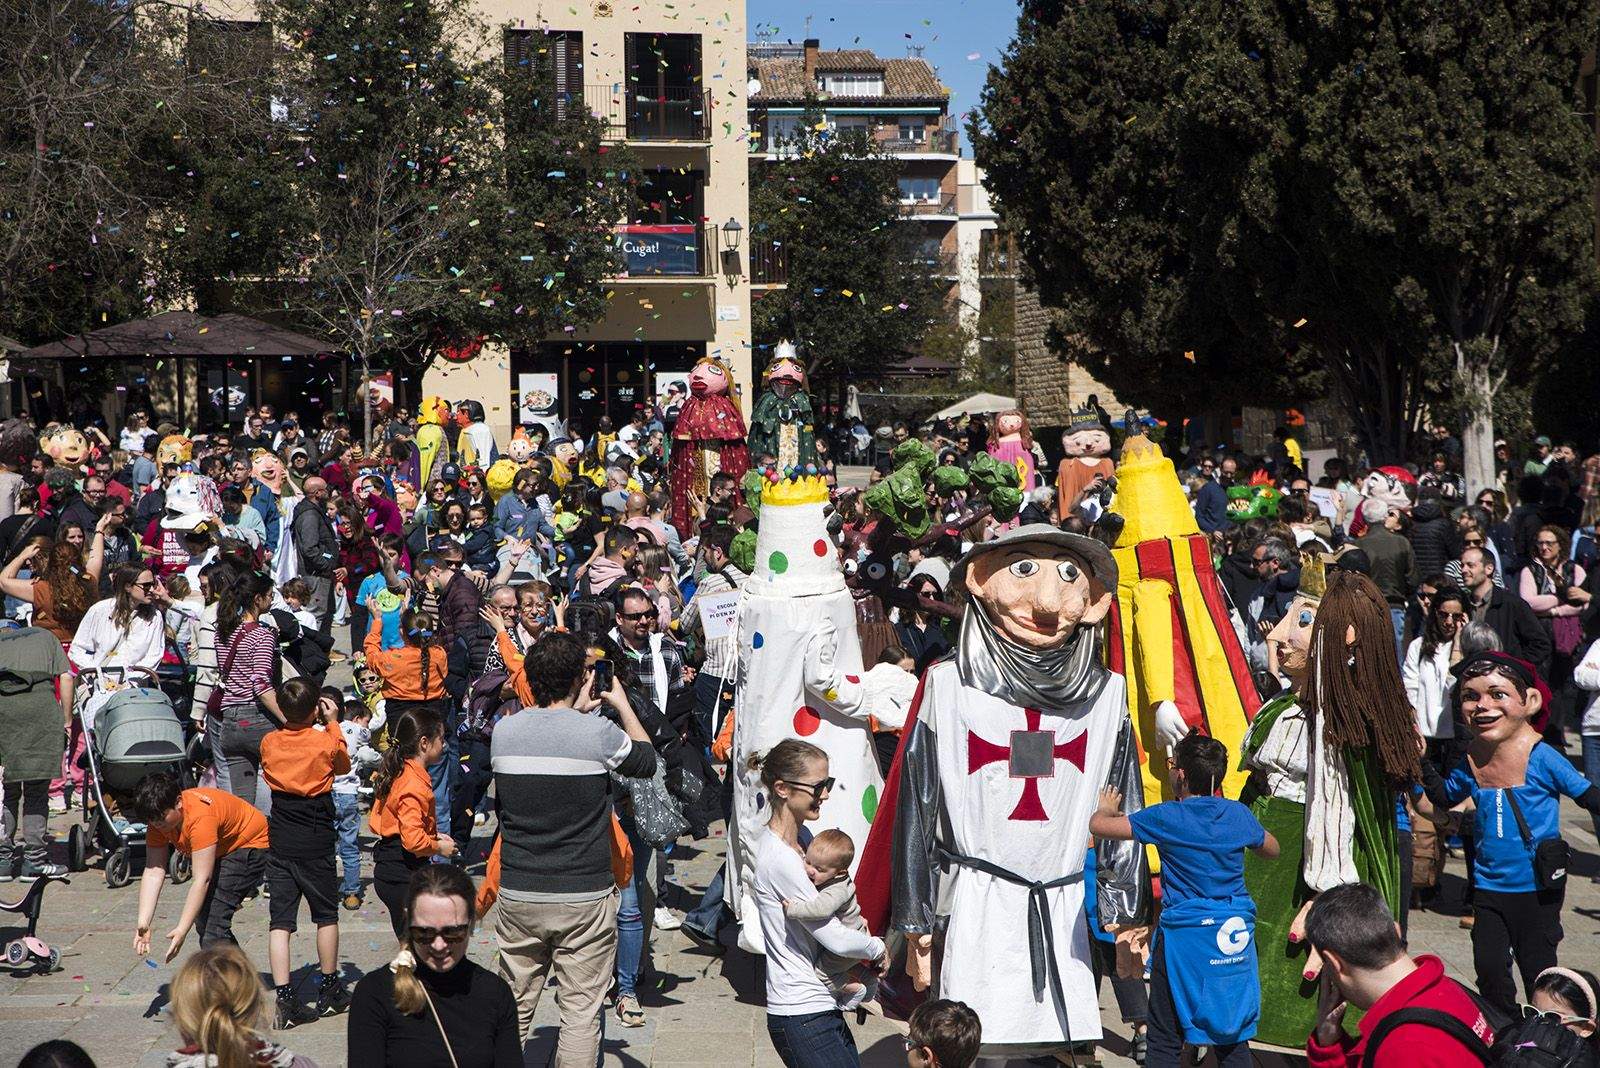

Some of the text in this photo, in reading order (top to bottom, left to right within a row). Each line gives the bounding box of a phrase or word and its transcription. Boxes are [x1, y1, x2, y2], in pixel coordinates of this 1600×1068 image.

[623, 241, 660, 257] Cugat!
[716, 601, 738, 610] ESCOLA
[1216, 916, 1250, 956] G
